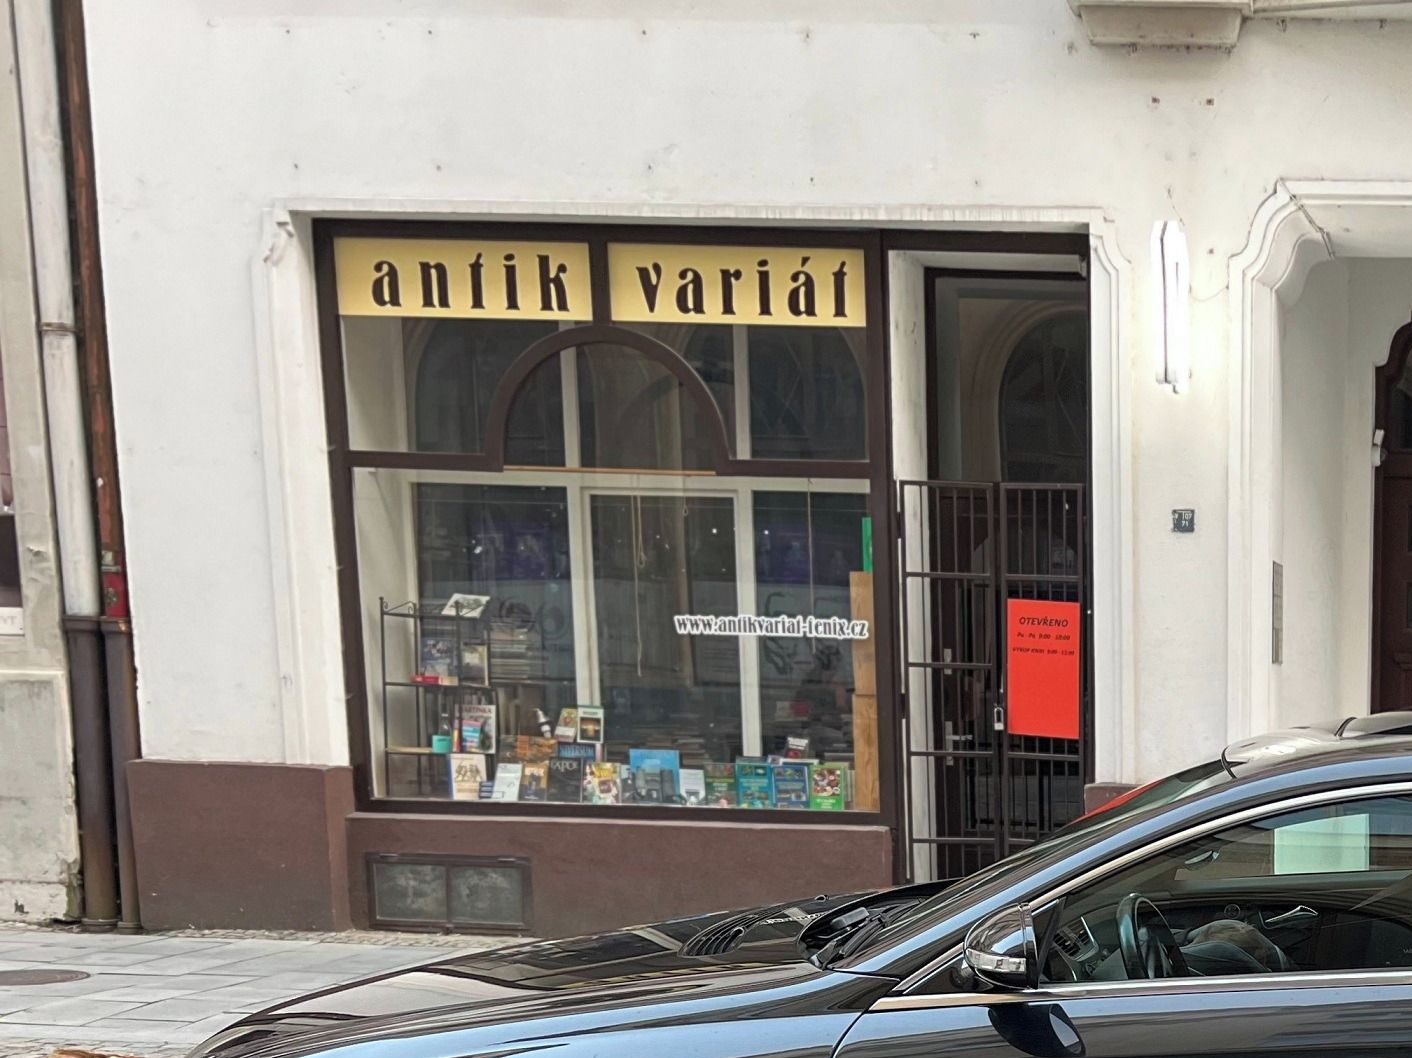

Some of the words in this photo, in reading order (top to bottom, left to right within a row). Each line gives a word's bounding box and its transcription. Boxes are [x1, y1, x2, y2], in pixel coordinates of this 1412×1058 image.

[371, 253, 570, 313] antik
[636, 257, 848, 318] variát
[1019, 616, 1068, 628] OTEVŘENO
